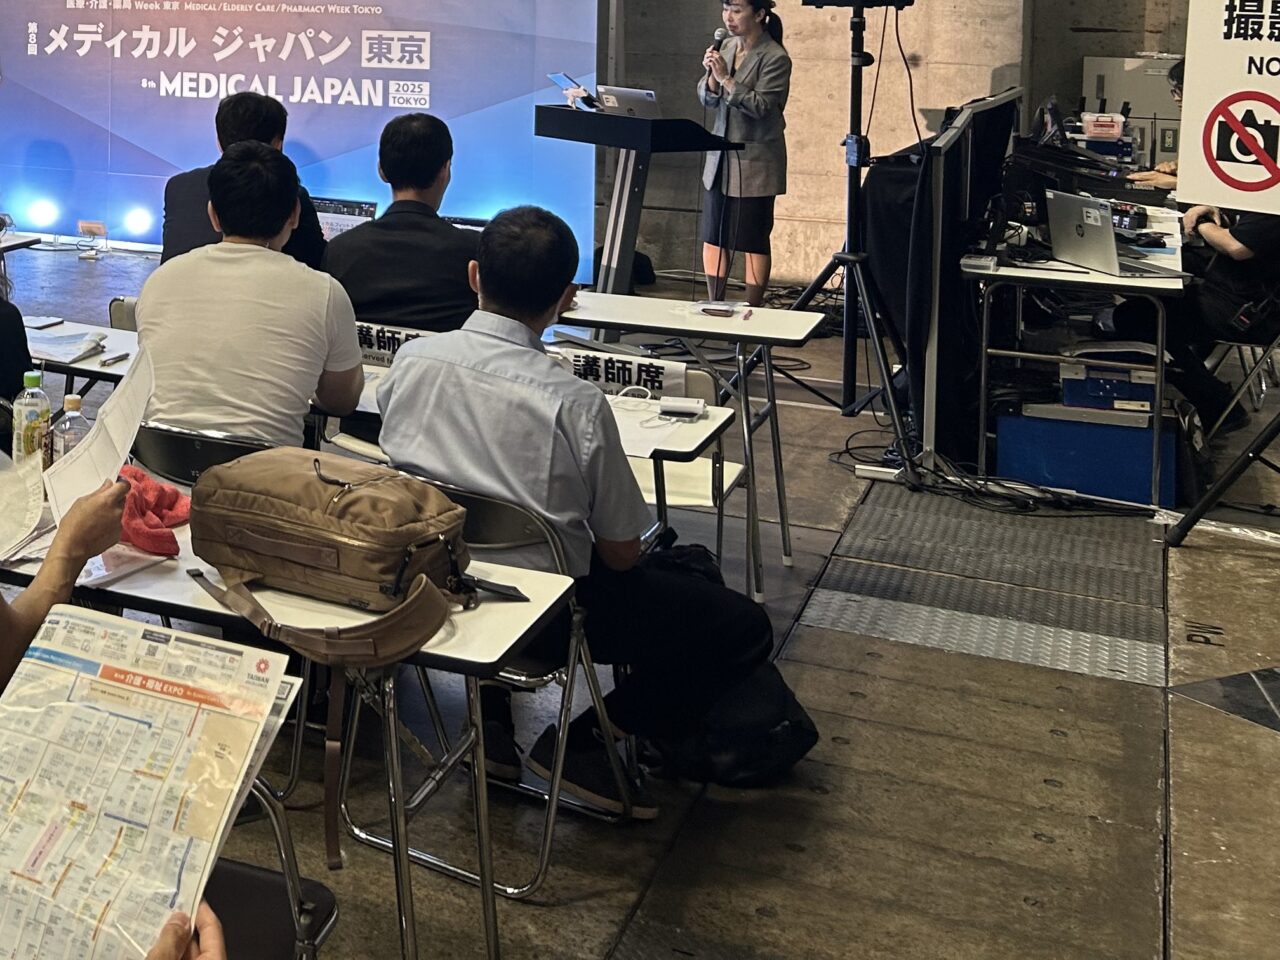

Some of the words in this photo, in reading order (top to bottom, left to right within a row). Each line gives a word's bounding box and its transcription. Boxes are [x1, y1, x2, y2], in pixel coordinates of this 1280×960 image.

[135, 0, 161, 11] Week
[163, 1, 180, 11] 東京
[44, 22, 197, 59] メディカル
[212, 25, 352, 66] ジャパン
[365, 34, 426, 65] 東京
[1247, 56, 1280, 76] NO
[141, 78, 157, 89] 8th
[159, 71, 283, 103] MEDICAL
[289, 76, 383, 106] JAPAN
[394, 83, 424, 93] 2025
[392, 96, 427, 106] TOKYO
[356, 324, 420, 355] 講師
[573, 354, 665, 390] 講師席
